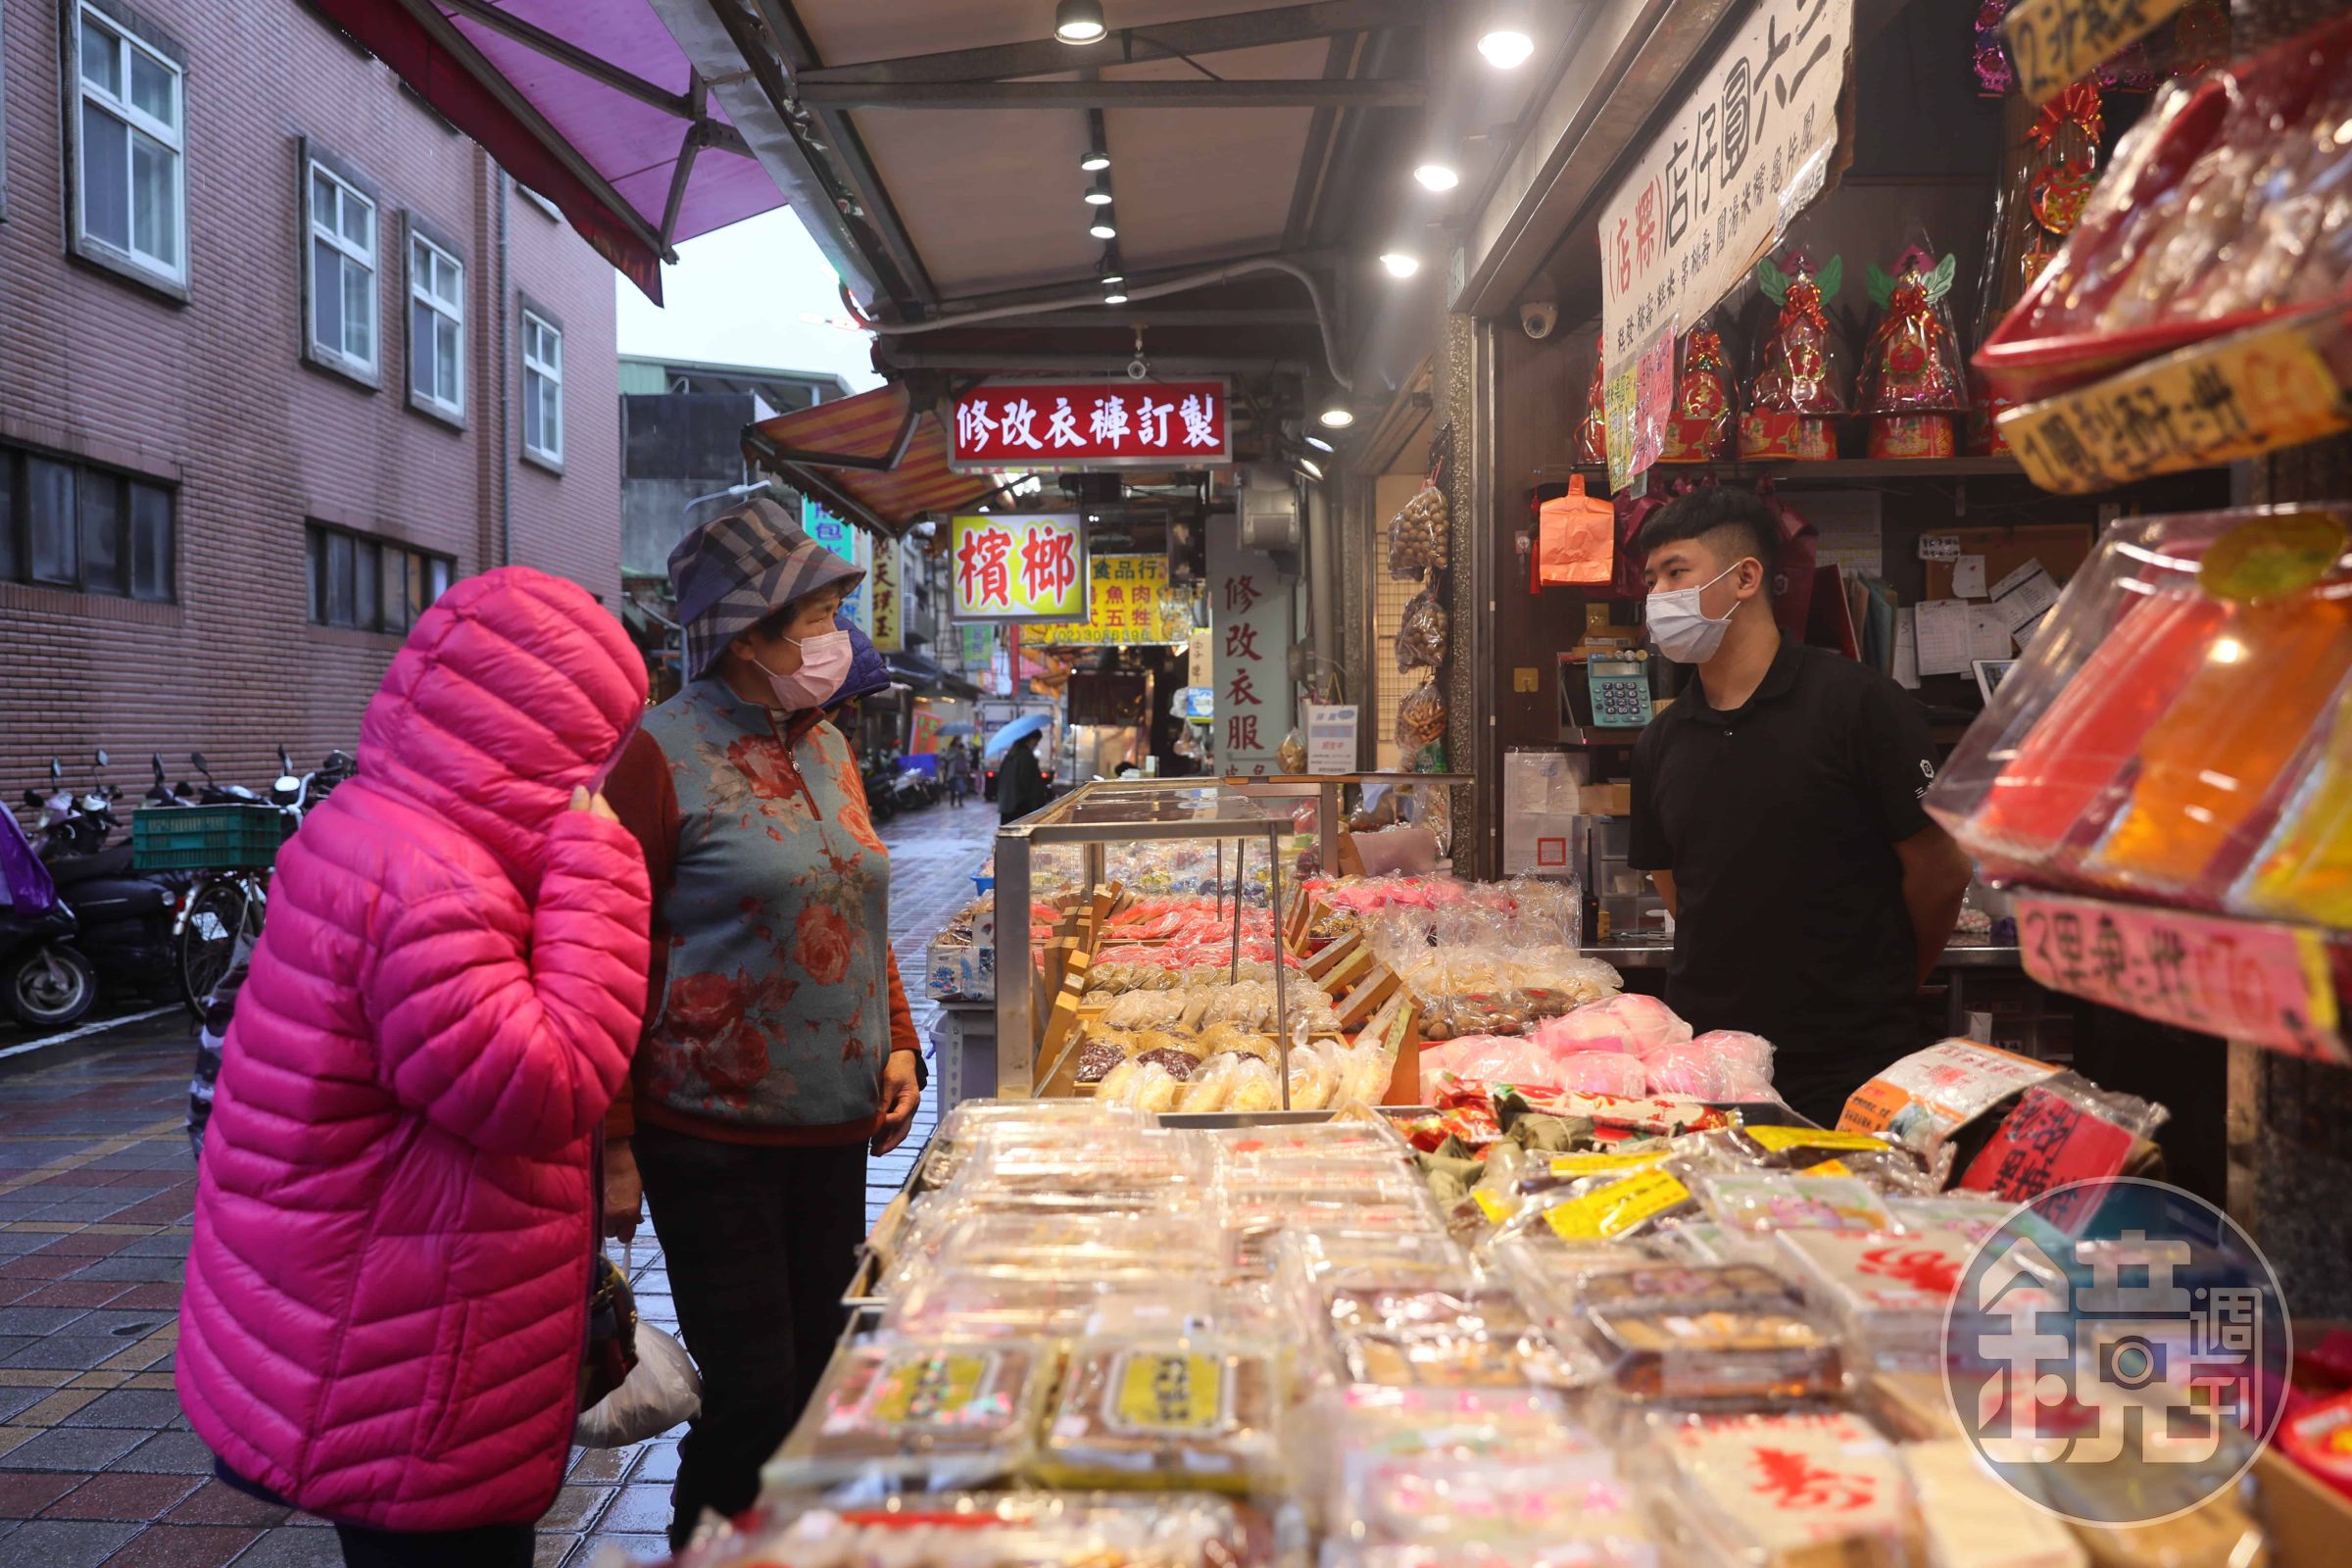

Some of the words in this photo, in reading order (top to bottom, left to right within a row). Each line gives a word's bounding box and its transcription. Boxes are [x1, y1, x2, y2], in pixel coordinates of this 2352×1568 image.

[956, 394, 1220, 453] 修改衣褲訂製
[957, 526, 1076, 607] 檳榔
[1093, 561, 1158, 580] 食品行
[1225, 575, 1264, 752] 修改衣服
